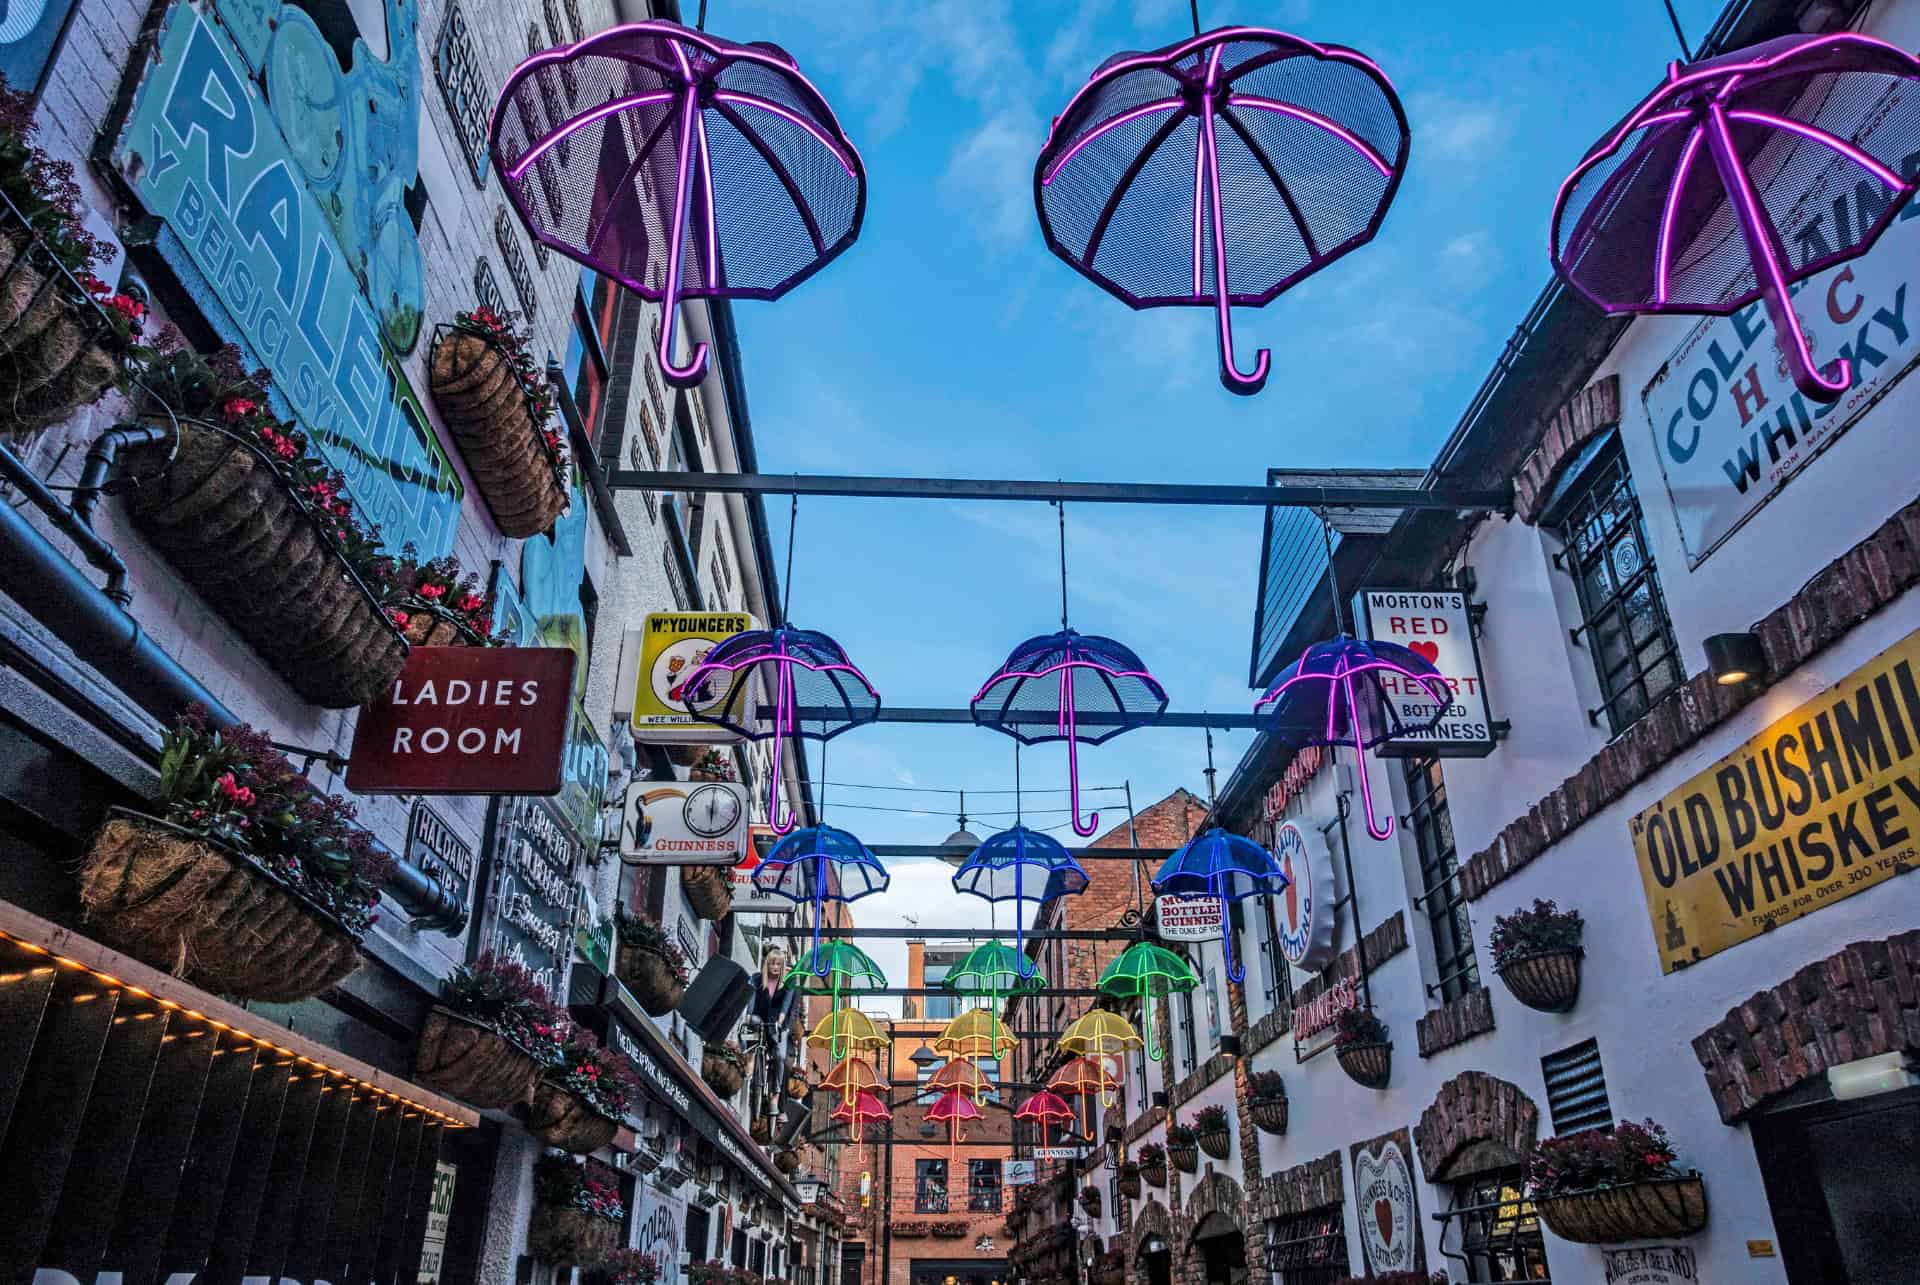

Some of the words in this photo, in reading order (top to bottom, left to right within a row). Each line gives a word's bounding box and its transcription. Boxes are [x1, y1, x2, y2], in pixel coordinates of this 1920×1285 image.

[147, 123, 180, 188] Y
[162, 14, 463, 558] RALEIGH
[1769, 452, 1800, 482] FROM
[1807, 416, 1836, 448] MALT
[1372, 594, 1462, 609] MORTON'S
[669, 616, 745, 633] YOUNGER'S
[1390, 617, 1449, 635] RED
[392, 679, 539, 706] LADIES
[392, 727, 522, 755] ROOM
[419, 811, 471, 881] HALDANE
[655, 839, 737, 851] GUINNESS
[1274, 828, 1301, 862] UALITY
[1752, 904, 1790, 927] FAMOUS
[1793, 894, 1812, 909] FOR
[1816, 880, 1844, 898] OVER
[1848, 865, 1872, 884] 300
[1161, 915, 1223, 927] GUINNES
